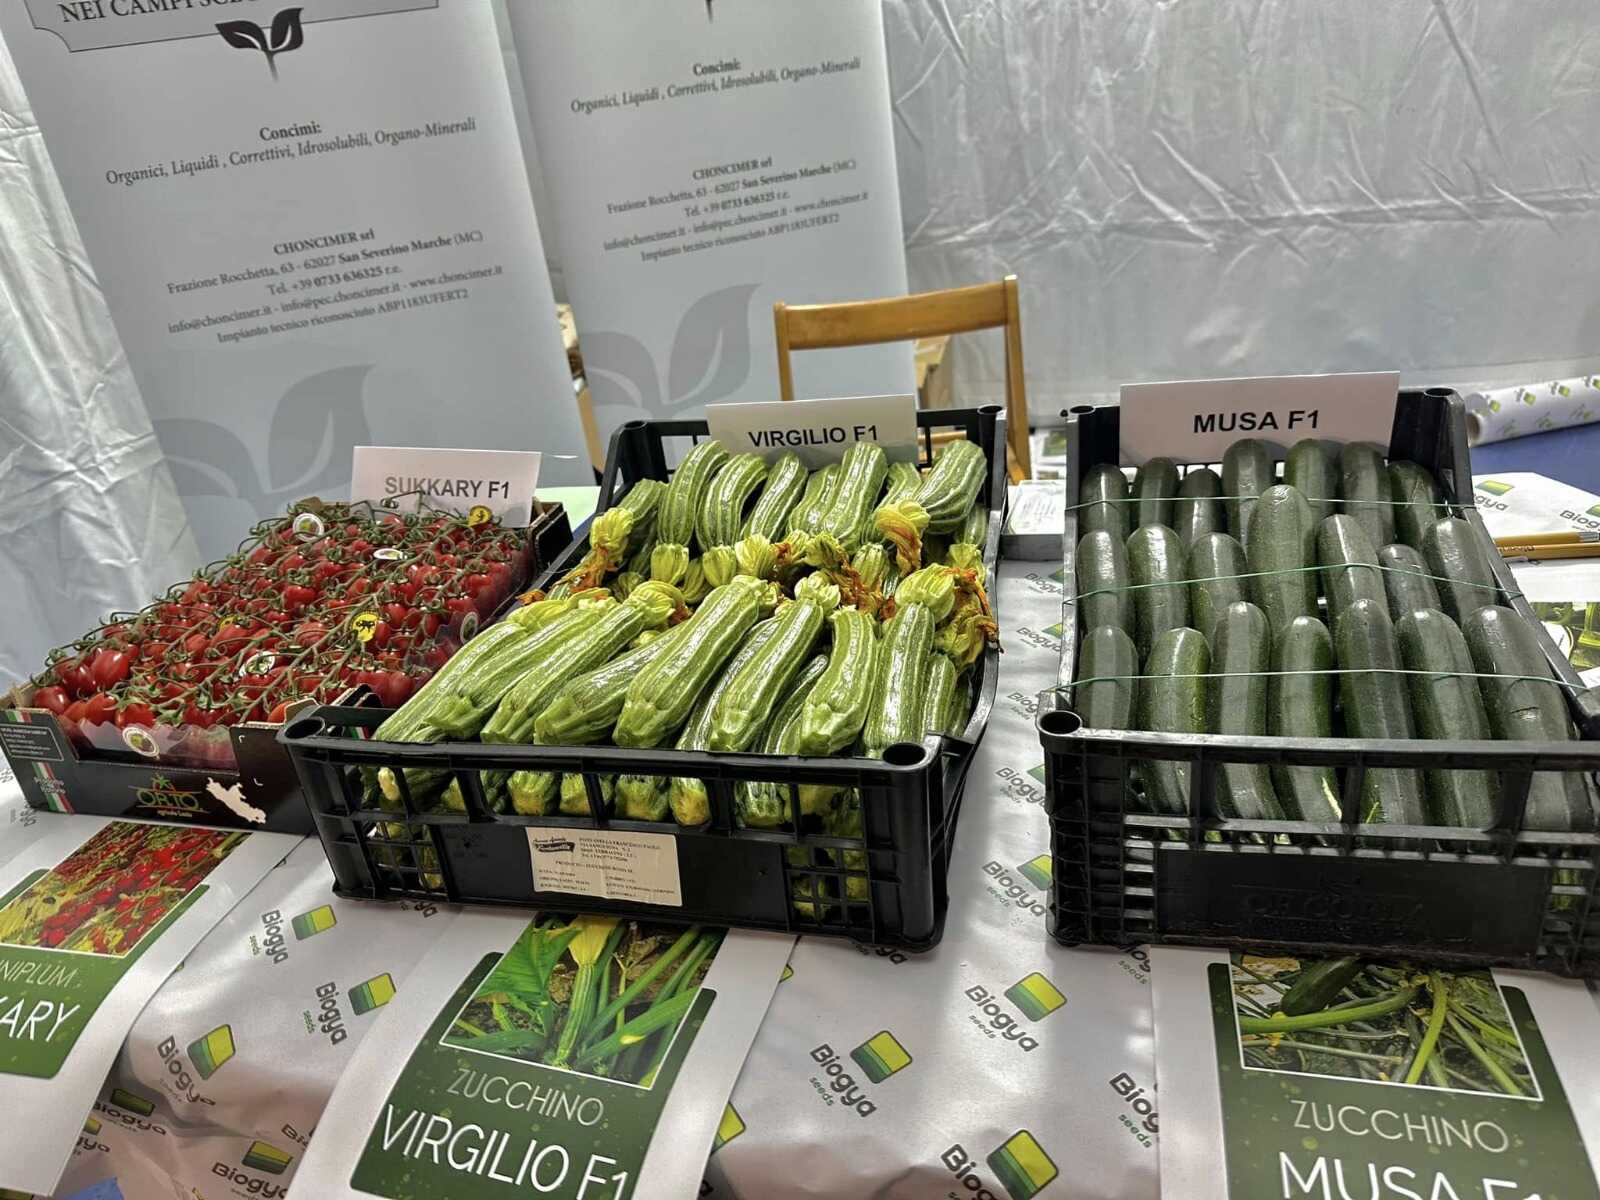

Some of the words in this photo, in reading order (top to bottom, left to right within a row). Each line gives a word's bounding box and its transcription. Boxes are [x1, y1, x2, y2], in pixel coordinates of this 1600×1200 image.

[58, 0, 107, 22] NEI
[692, 57, 741, 76] Concimi:
[570, 95, 621, 115] Organici,
[622, 86, 660, 107] Liquidi
[667, 79, 720, 99] Correttivi,
[105, 162, 169, 187] Organici,
[170, 154, 220, 179] Liquidi
[228, 144, 296, 167] Correttivi,
[297, 132, 372, 157] Idrosolubili,
[374, 116, 477, 146] Organo-Minerali
[259, 120, 323, 142] Concimi:
[166, 274, 219, 294] Frazione
[219, 266, 279, 285] Rocchetta,
[279, 261, 295, 274] 63
[303, 254, 336, 270] 62027
[338, 252, 360, 264] San
[361, 243, 410, 260] Severino
[410, 235, 452, 251] Marche
[453, 229, 484, 246] (MC)
[273, 231, 358, 256] CHONCIMER
[358, 228, 375, 241] srl
[167, 305, 273, 334] info@choncimer.it
[279, 281, 400, 313] info@pec.choncimer.it
[408, 265, 503, 289] www.choncimer.it
[266, 281, 288, 296] Tel.
[292, 278, 313, 292] +39
[313, 272, 342, 289] 0733
[343, 266, 384, 283] 636325
[216, 325, 269, 344] Impianto
[269, 317, 309, 334] tecnico
[310, 305, 376, 326] riconosciuto
[747, 426, 847, 449] VIRGILIO
[853, 424, 879, 444] F1
[1193, 411, 1280, 434] MUSA
[1287, 409, 1320, 430] F1
[384, 475, 485, 500] SUKKARY
[487, 479, 510, 499] F1
[136, 788, 199, 810] ORTO
[982, 860, 1046, 917] Biogya
[261, 909, 289, 964] Biogya
[315, 982, 348, 1046] Biogya
[963, 984, 1040, 1053] Biogya
[968, 1013, 997, 1040] seeds
[157, 1035, 217, 1106] Biogya
[808, 1076, 835, 1107] seeds
[809, 1043, 877, 1119] Biogya
[446, 1068, 605, 1126] ZUCCHINO
[1109, 1071, 1158, 1134] Biog
[383, 1103, 570, 1193] VIRGILIO
[1117, 1113, 1153, 1148] seeds
[1290, 1099, 1510, 1153] ZUCCHINO
[1278, 1151, 1464, 1200] MUSA
